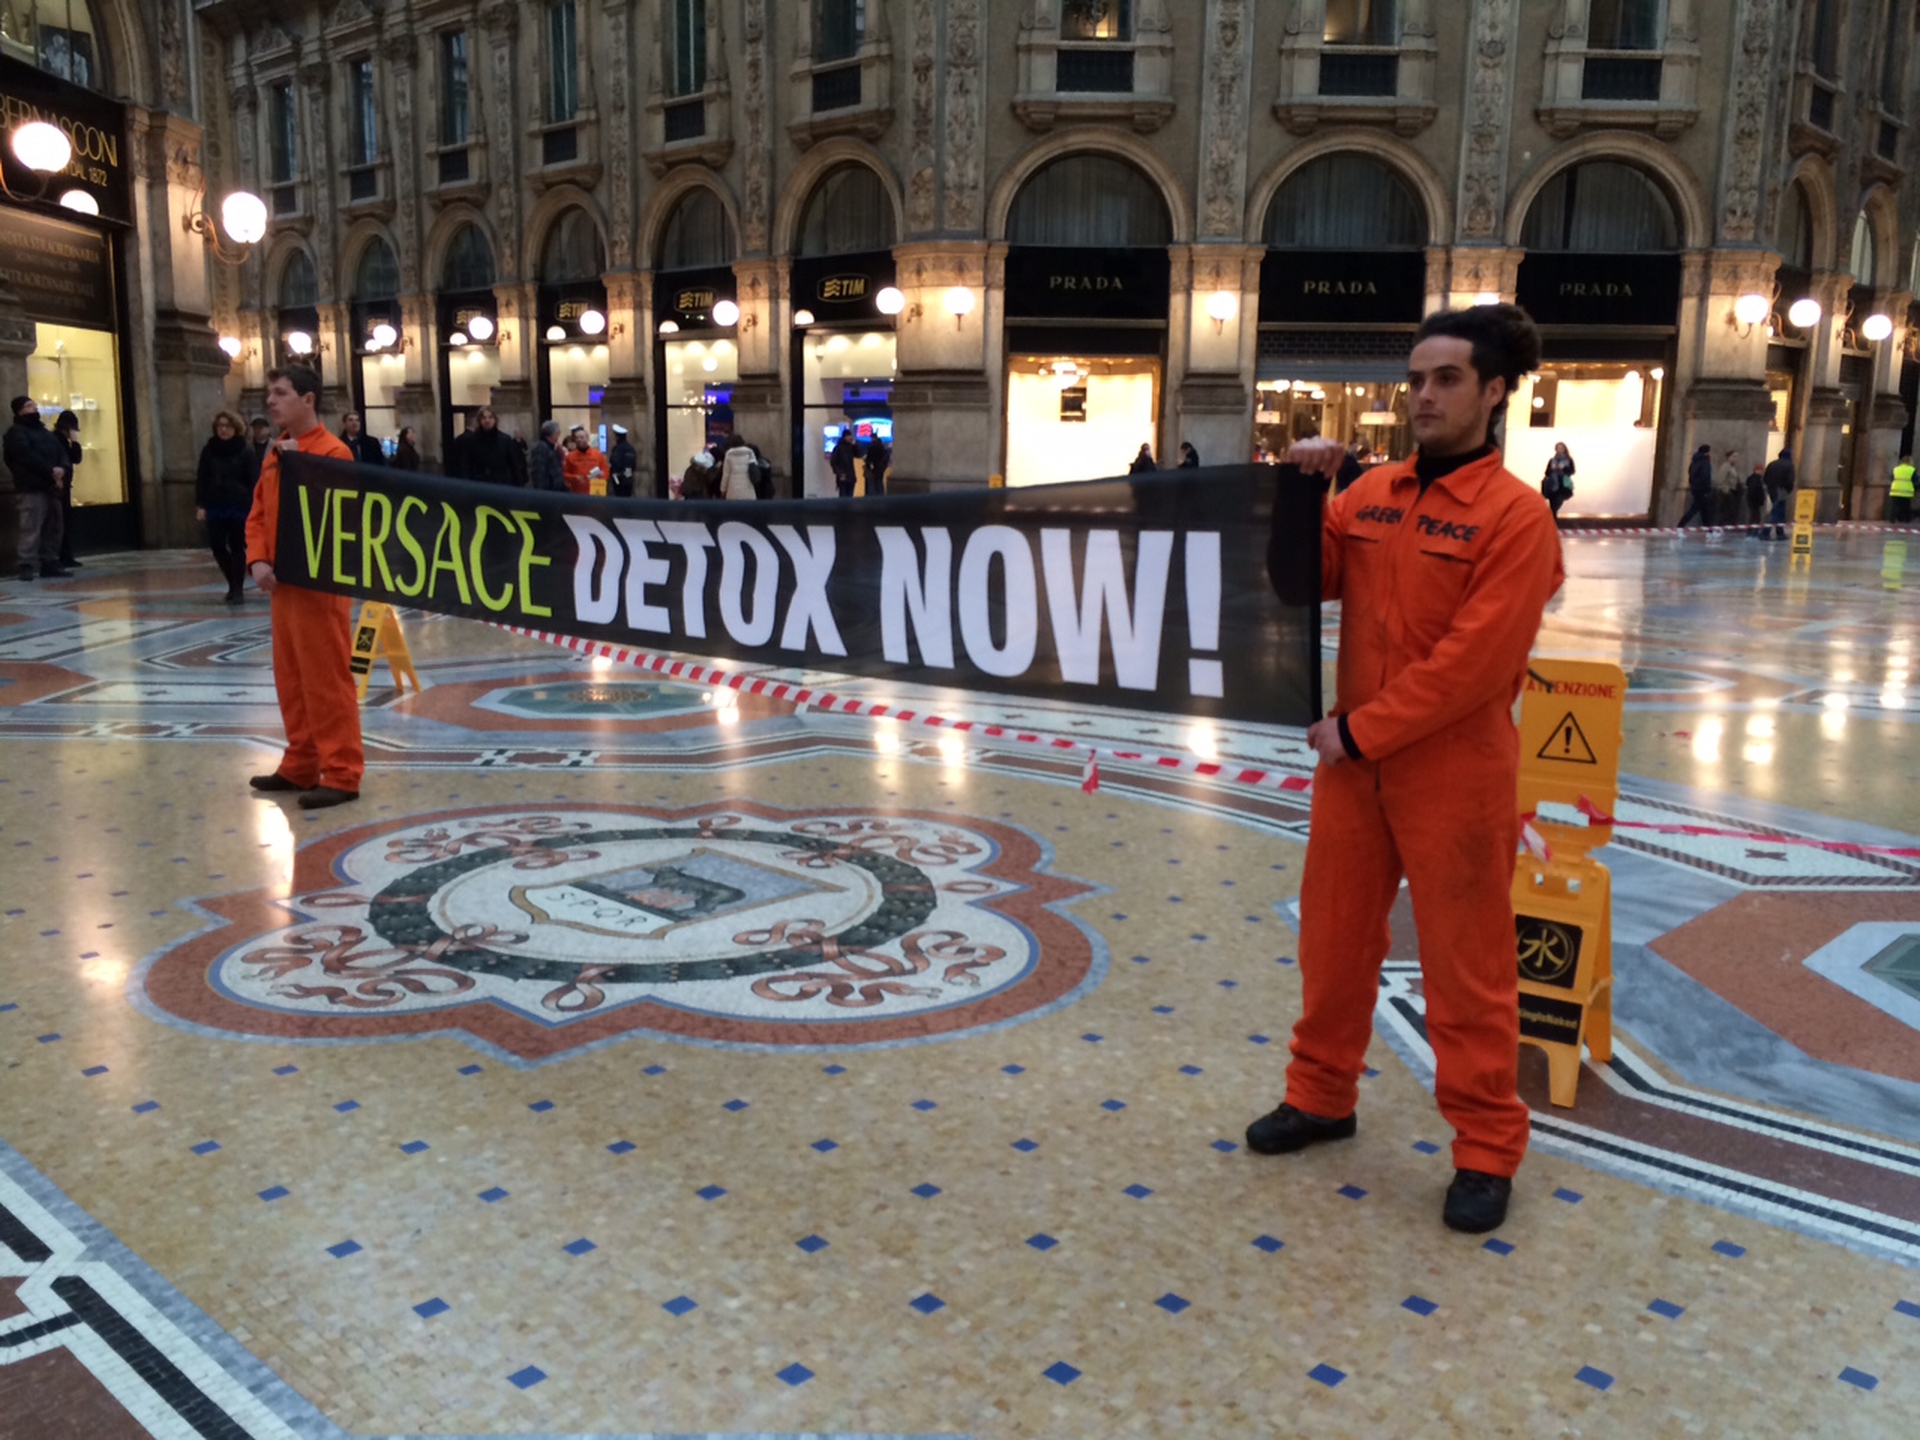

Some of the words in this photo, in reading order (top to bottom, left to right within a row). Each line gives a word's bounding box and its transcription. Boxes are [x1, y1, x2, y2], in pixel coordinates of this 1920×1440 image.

[842, 279, 865, 296] TIM
[1049, 276, 1123, 290] PRADA
[1303, 281, 1377, 294] PRADA
[1560, 282, 1633, 296] PRADA
[693, 292, 713, 307] TIM
[1356, 504, 1405, 524] GREEN
[1416, 514, 1481, 542] PEACE
[298, 486, 552, 617] VERSACE
[562, 514, 847, 657] DETOX
[875, 525, 1224, 698] NOW!
[1526, 678, 1616, 699] ATENZIONE
[545, 892, 648, 926] SPQR
